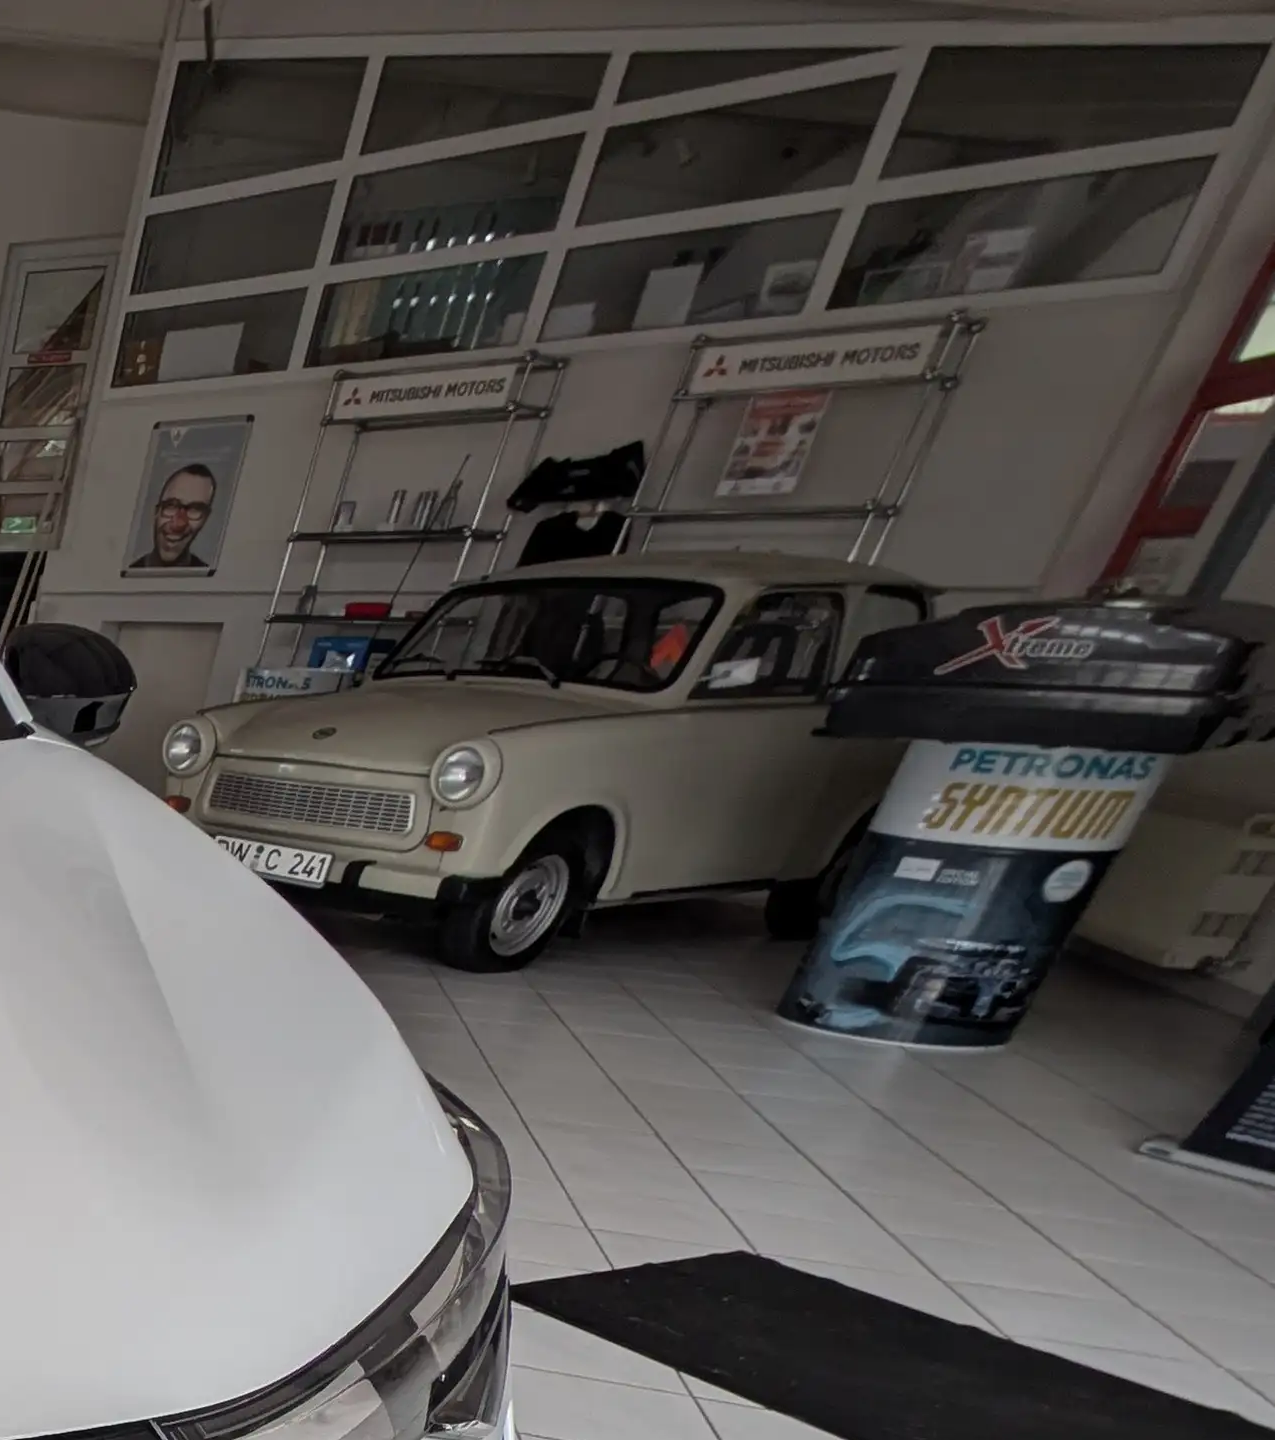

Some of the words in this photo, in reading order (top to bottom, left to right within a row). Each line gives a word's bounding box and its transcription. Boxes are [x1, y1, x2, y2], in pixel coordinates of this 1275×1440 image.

[737, 351, 836, 375] MITSUBISHI
[841, 343, 921, 366] MOTORS
[368, 385, 443, 404] MITSUBISHI
[444, 377, 507, 398] MOTORS
[950, 748, 1156, 780] PETRONAS
[922, 781, 1136, 840] SYNTIUM
[265, 849, 282, 871] C
[288, 852, 327, 880] 241
